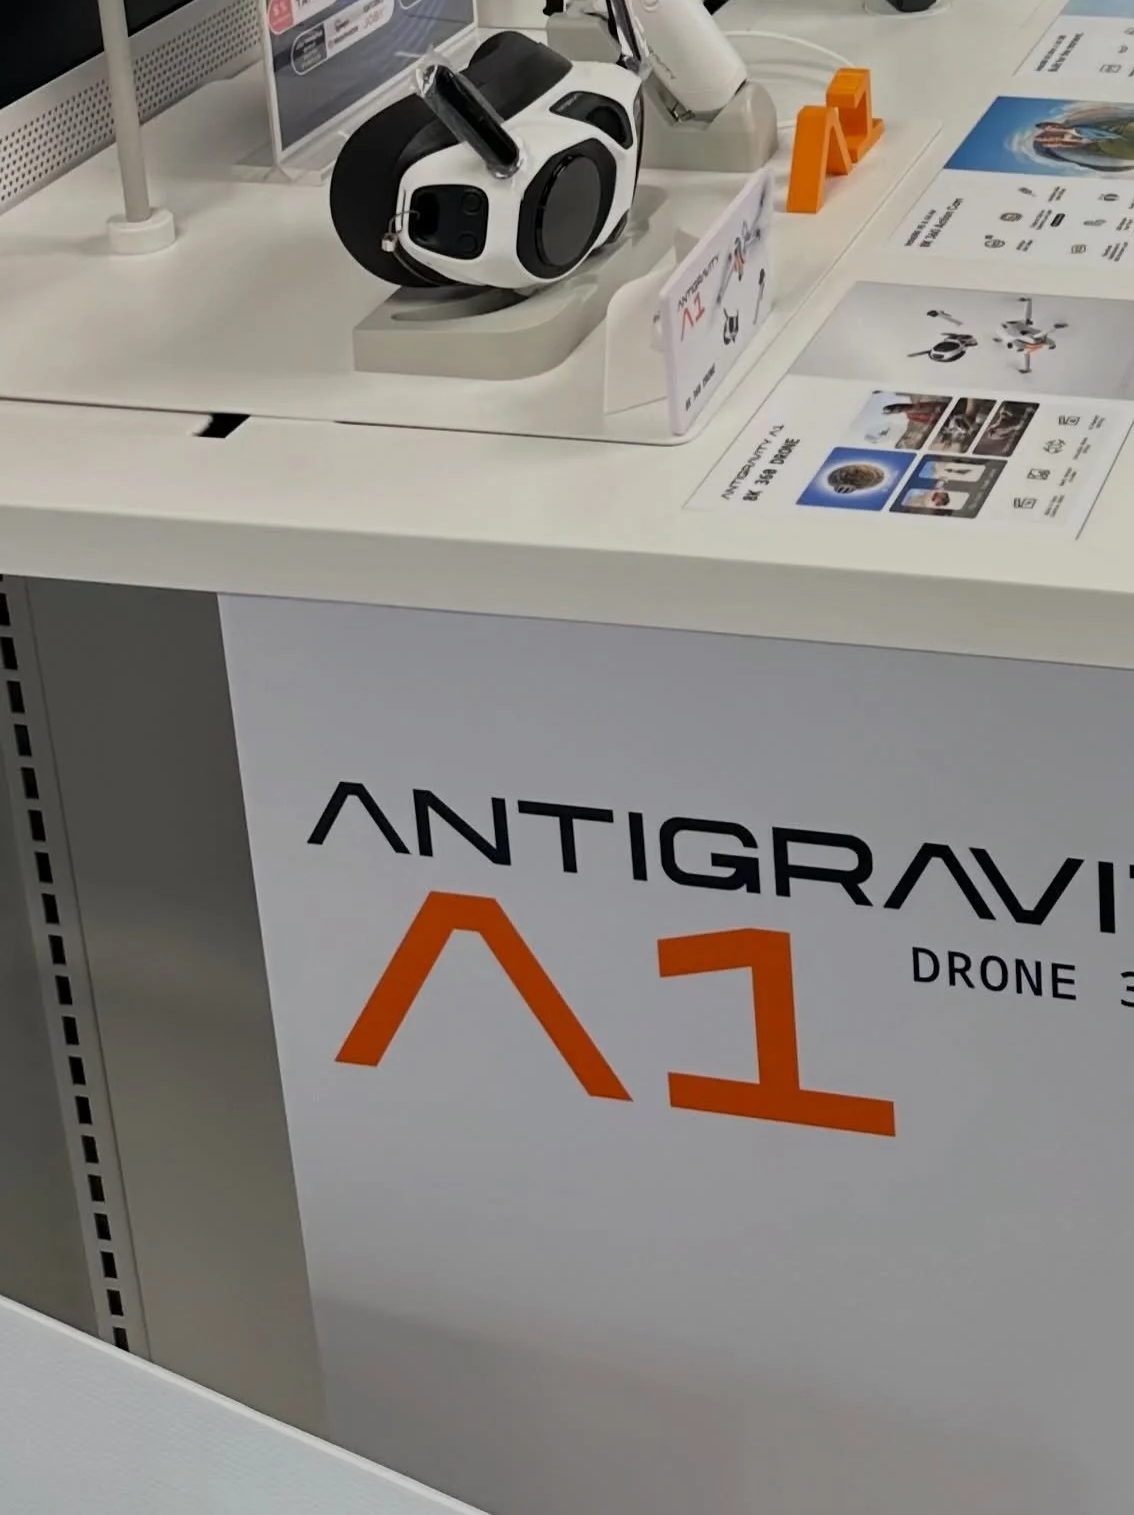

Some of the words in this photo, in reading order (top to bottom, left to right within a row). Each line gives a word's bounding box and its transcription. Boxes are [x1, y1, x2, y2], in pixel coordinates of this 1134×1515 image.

[721, 438, 772, 501] ANTIGRAVITY
[769, 437, 801, 465] DRONE
[912, 946, 1079, 1002] DRONE
[334, 890, 897, 1138] A1
